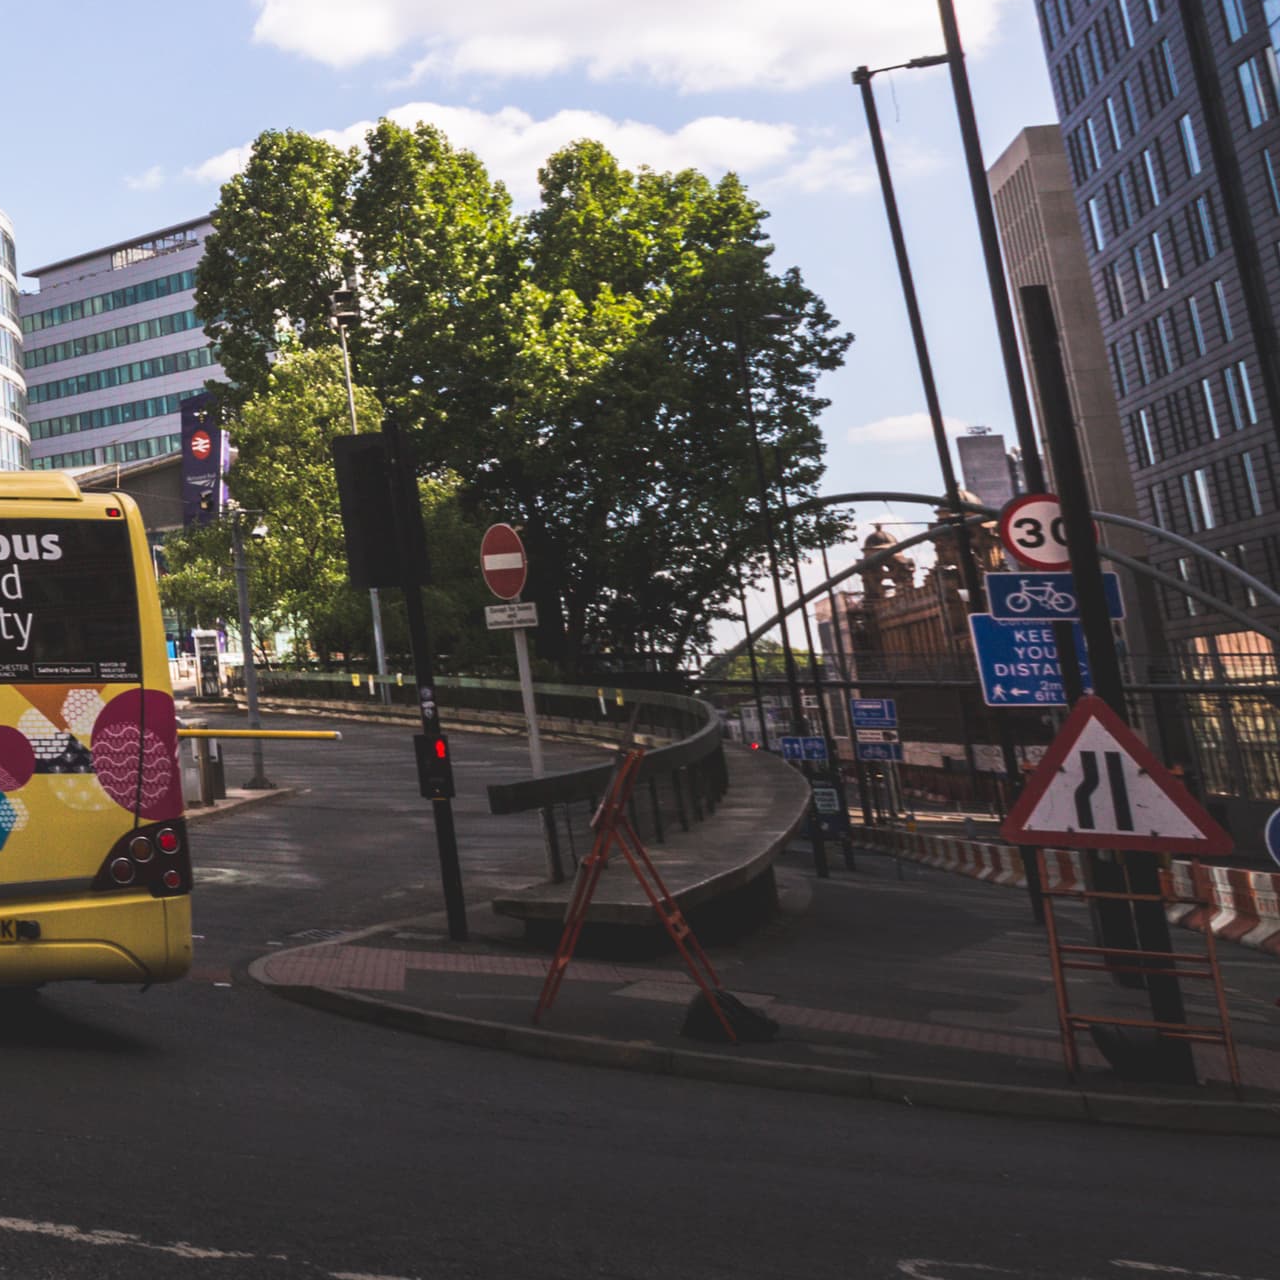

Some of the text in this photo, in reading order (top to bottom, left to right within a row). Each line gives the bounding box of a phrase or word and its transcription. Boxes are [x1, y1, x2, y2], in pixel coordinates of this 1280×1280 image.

[1013, 629, 1055, 643] KEE
[1013, 646, 1058, 660] YOU
[994, 663, 1062, 677] DISTA
